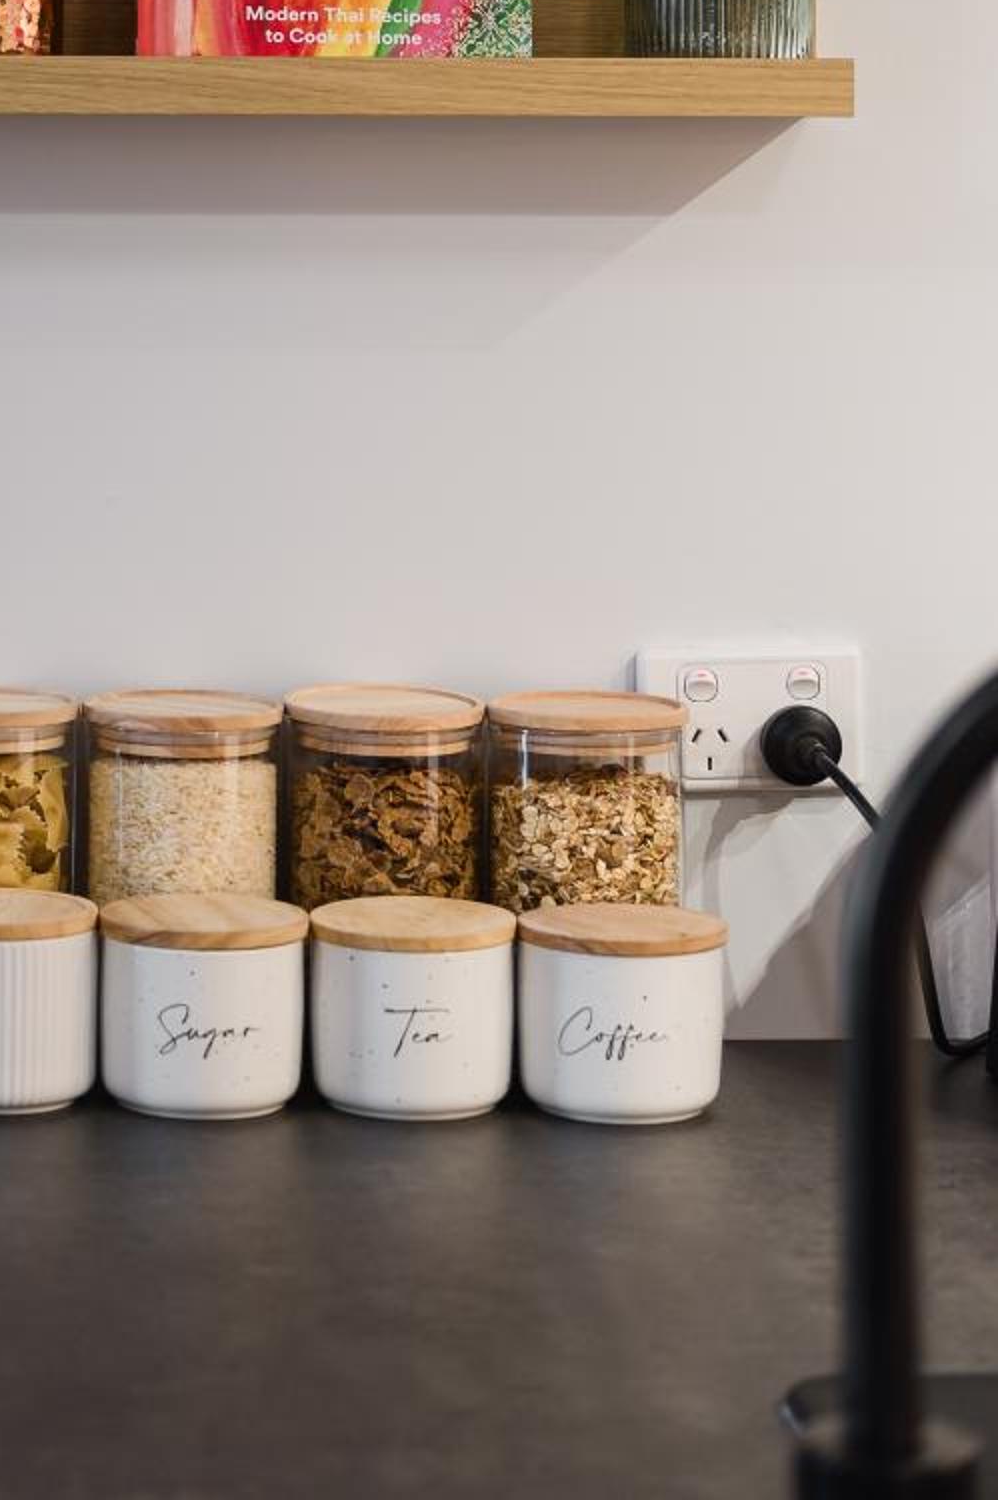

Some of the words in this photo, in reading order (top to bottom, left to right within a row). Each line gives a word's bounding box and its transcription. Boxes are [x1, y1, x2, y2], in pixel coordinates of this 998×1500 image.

[245, 5, 319, 22] Modern
[324, 7, 365, 23] Thai
[369, 8, 442, 27] Recipes
[265, 29, 285, 44] to
[289, 29, 338, 44] Cook
[345, 32, 363, 45] at
[367, 30, 423, 45] Home
[157, 1003, 261, 1059] Sugar
[384, 1007, 454, 1057] Tea
[558, 1006, 670, 1060] Coffee
